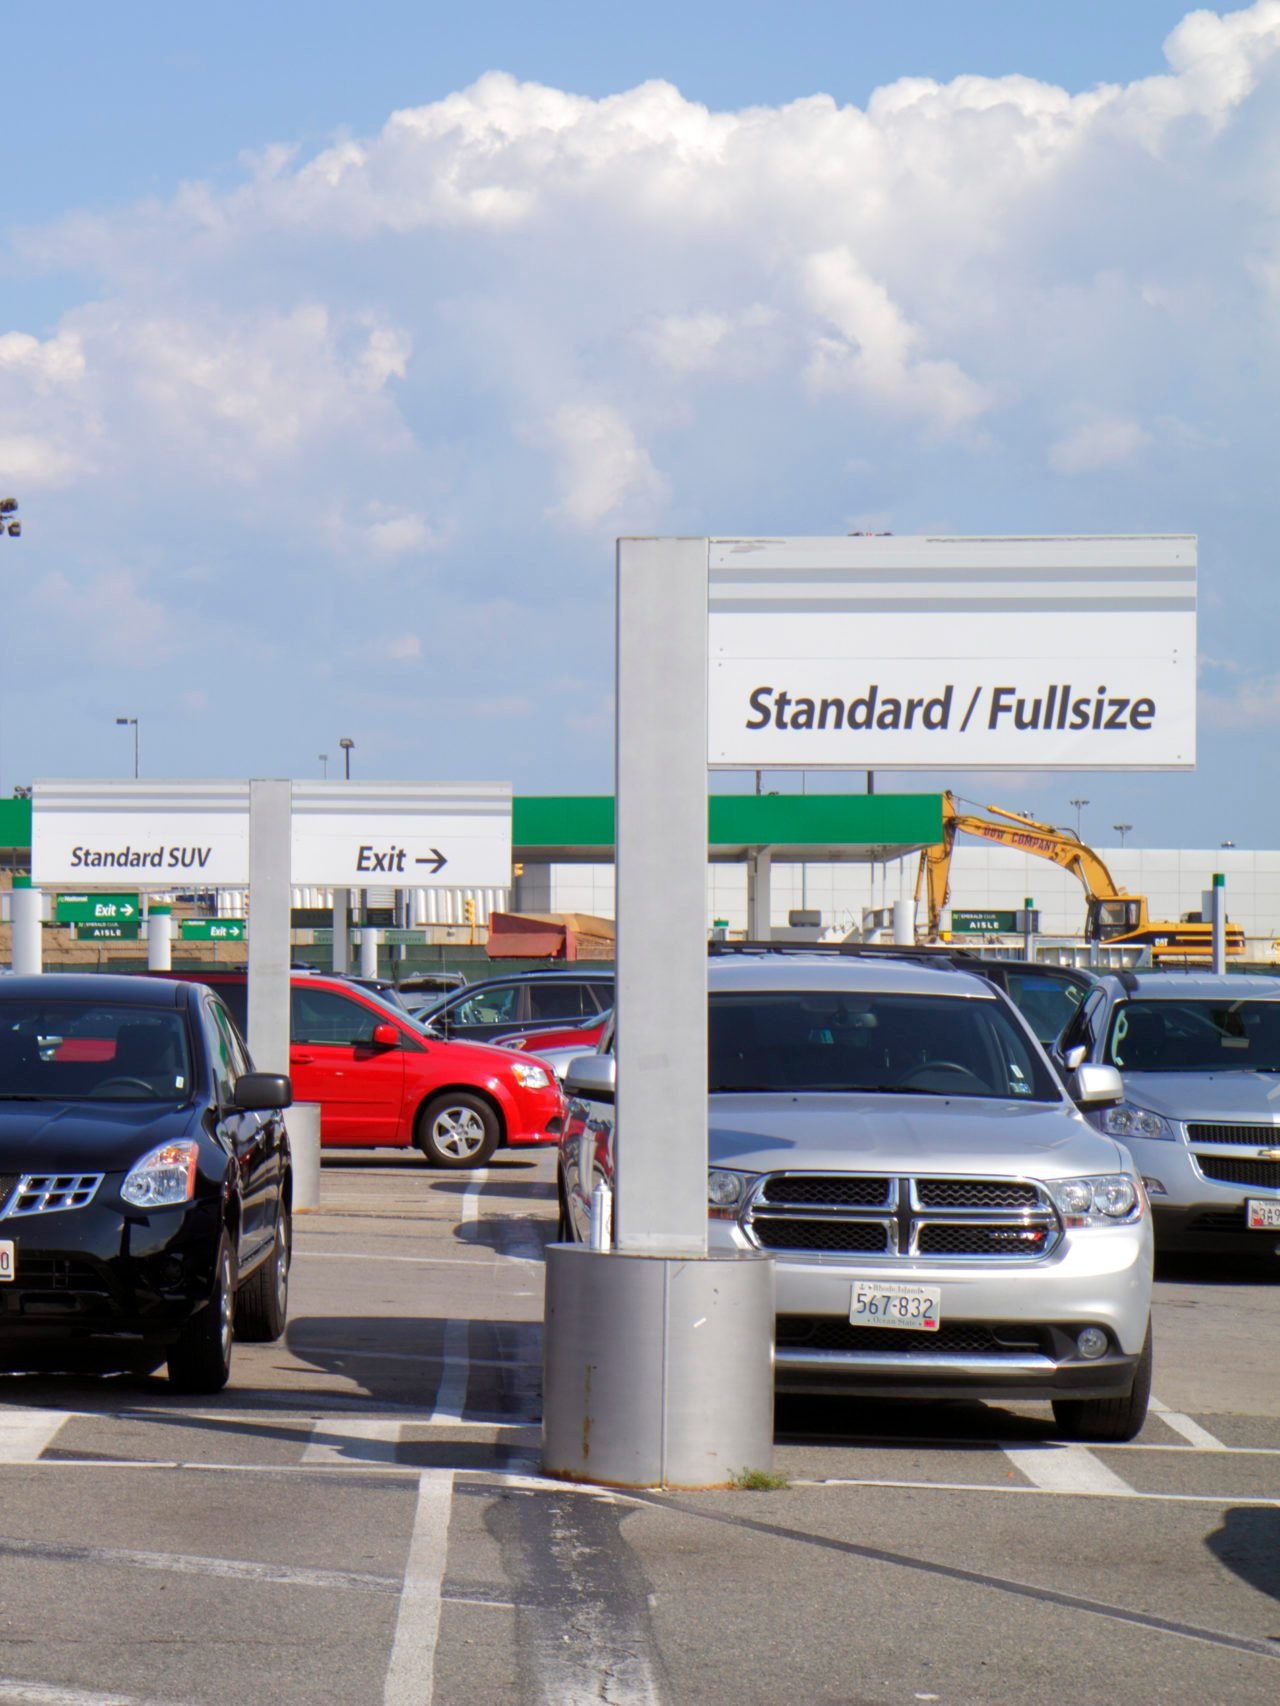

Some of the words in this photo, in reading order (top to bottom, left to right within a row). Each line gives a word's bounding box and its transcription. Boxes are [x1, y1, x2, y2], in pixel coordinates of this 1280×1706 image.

[745, 684, 954, 731] Standard
[987, 684, 1156, 731] Fullsize
[70, 846, 165, 868] Standard
[167, 847, 212, 868] SUV
[356, 845, 407, 873] Exit
[95, 903, 117, 917] Exit
[210, 926, 227, 936] Exit
[969, 921, 999, 929] AISLE
[94, 929, 122, 937] AISLE
[1154, 938, 1168, 947] CAT
[856, 1293, 933, 1319] 567-832
